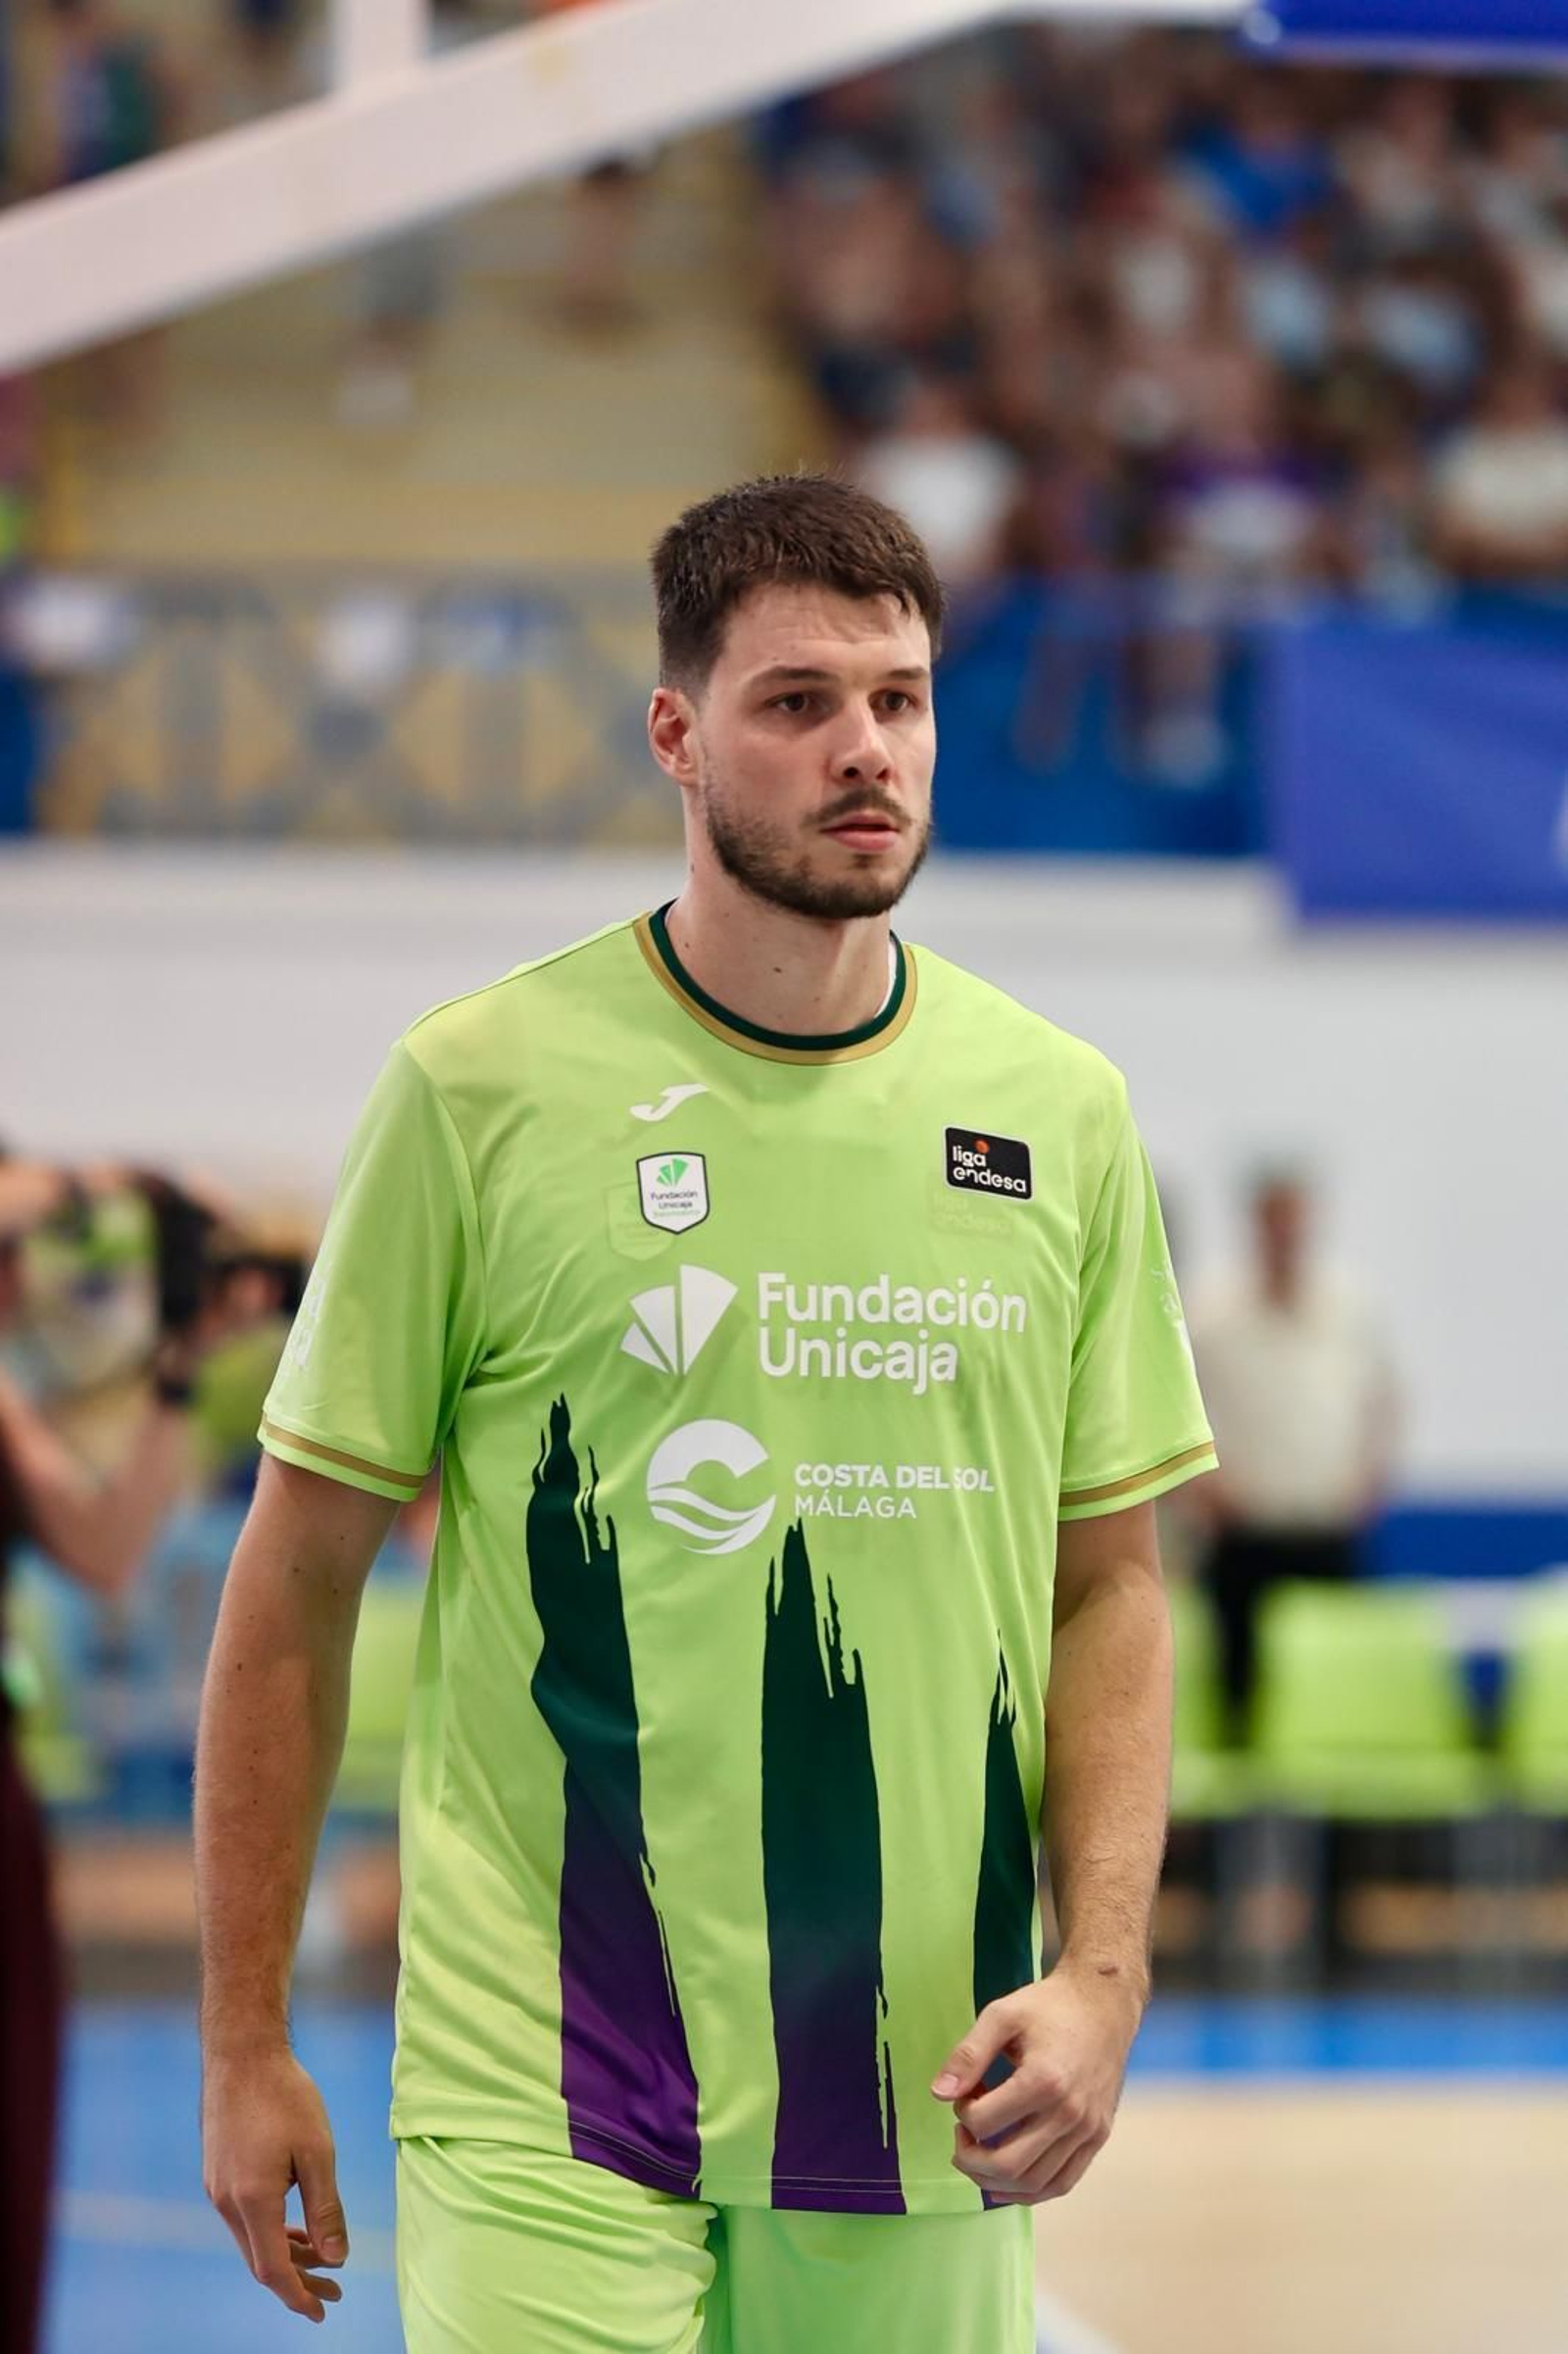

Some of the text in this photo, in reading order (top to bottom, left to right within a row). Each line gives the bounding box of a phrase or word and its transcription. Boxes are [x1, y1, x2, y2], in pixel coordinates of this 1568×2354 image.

[952, 1145, 987, 1167] liga
[953, 1166, 1028, 1193] endesa
[758, 1271, 1027, 1333] Fundación
[759, 1326, 958, 1396] Unicaja
[794, 1463, 996, 1493] COSTA DEL SOL
[794, 1489, 917, 1519] MÁLAGA
